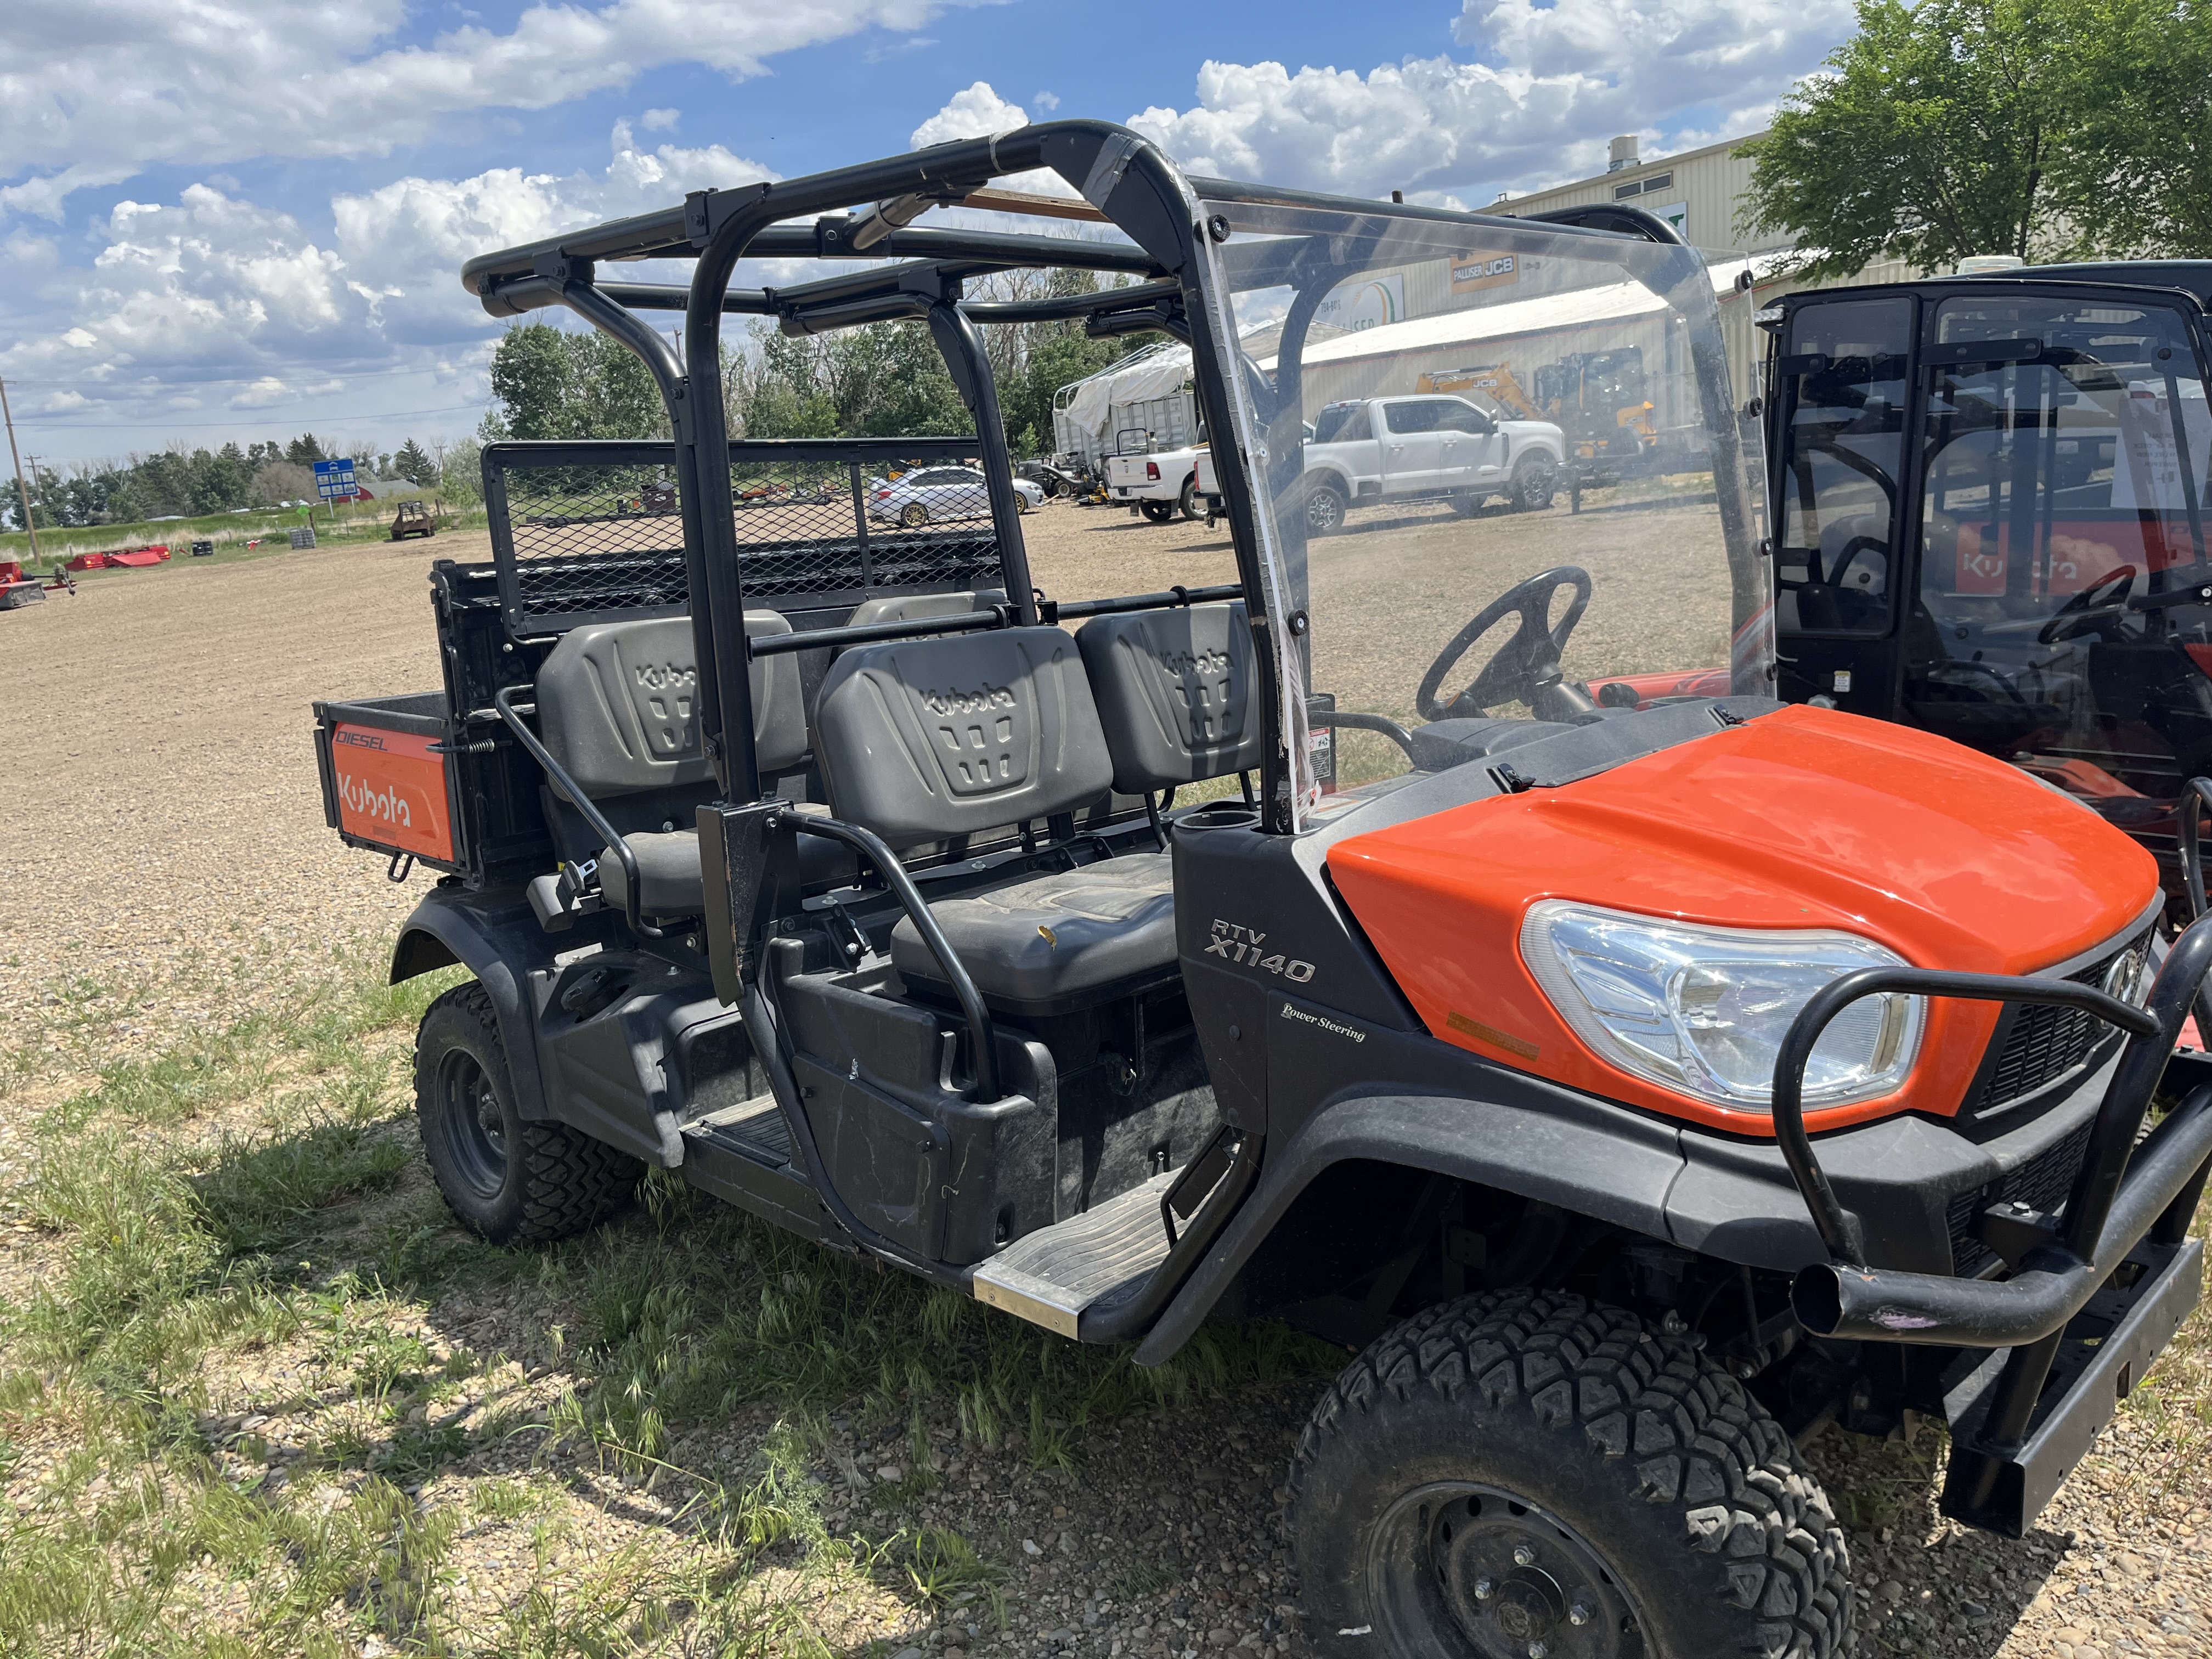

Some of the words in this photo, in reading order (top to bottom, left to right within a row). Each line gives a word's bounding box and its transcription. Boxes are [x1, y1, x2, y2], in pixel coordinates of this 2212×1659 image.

[1454, 266, 1482, 281] PALLISER
[1485, 257, 1513, 275] JCB
[1473, 379, 1497, 387] JCB
[636, 663, 696, 690] Kubo
[1160, 648, 1234, 678] Kubota
[919, 682, 1015, 717] Kubota
[336, 731, 388, 751] DIESEL
[338, 772, 410, 827] Kubota
[1211, 918, 1266, 945] RTV
[1204, 934, 1316, 983] X1140
[1282, 1004, 1318, 1024] Power
[1318, 1017, 1365, 1043] Steering
